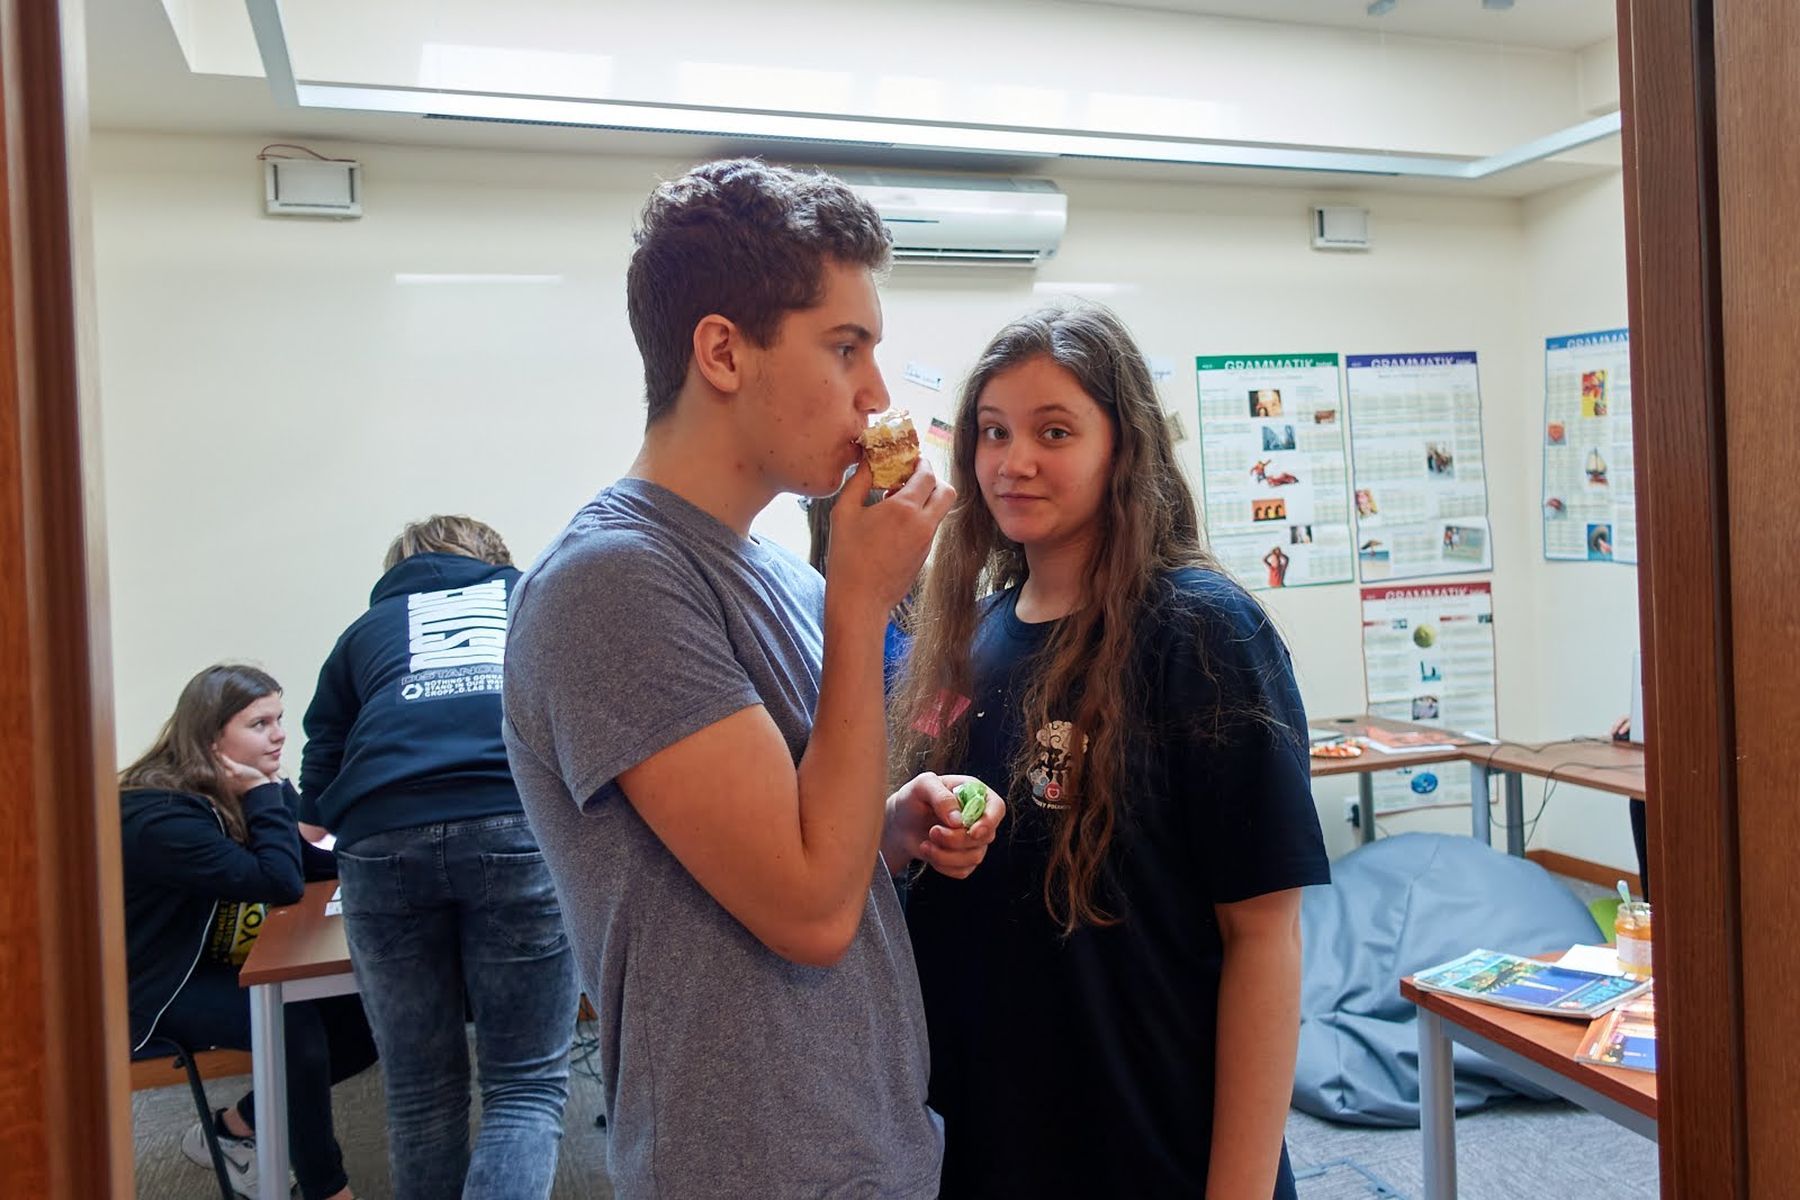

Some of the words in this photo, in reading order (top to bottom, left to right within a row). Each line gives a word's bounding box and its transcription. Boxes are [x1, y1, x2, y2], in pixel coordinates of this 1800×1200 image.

[1567, 332, 1630, 348] GRAMMA
[1224, 359, 1313, 370] GRAMMATIK
[1370, 357, 1453, 368] GRAMMATIK
[1384, 587, 1468, 600] GRAMMATIK
